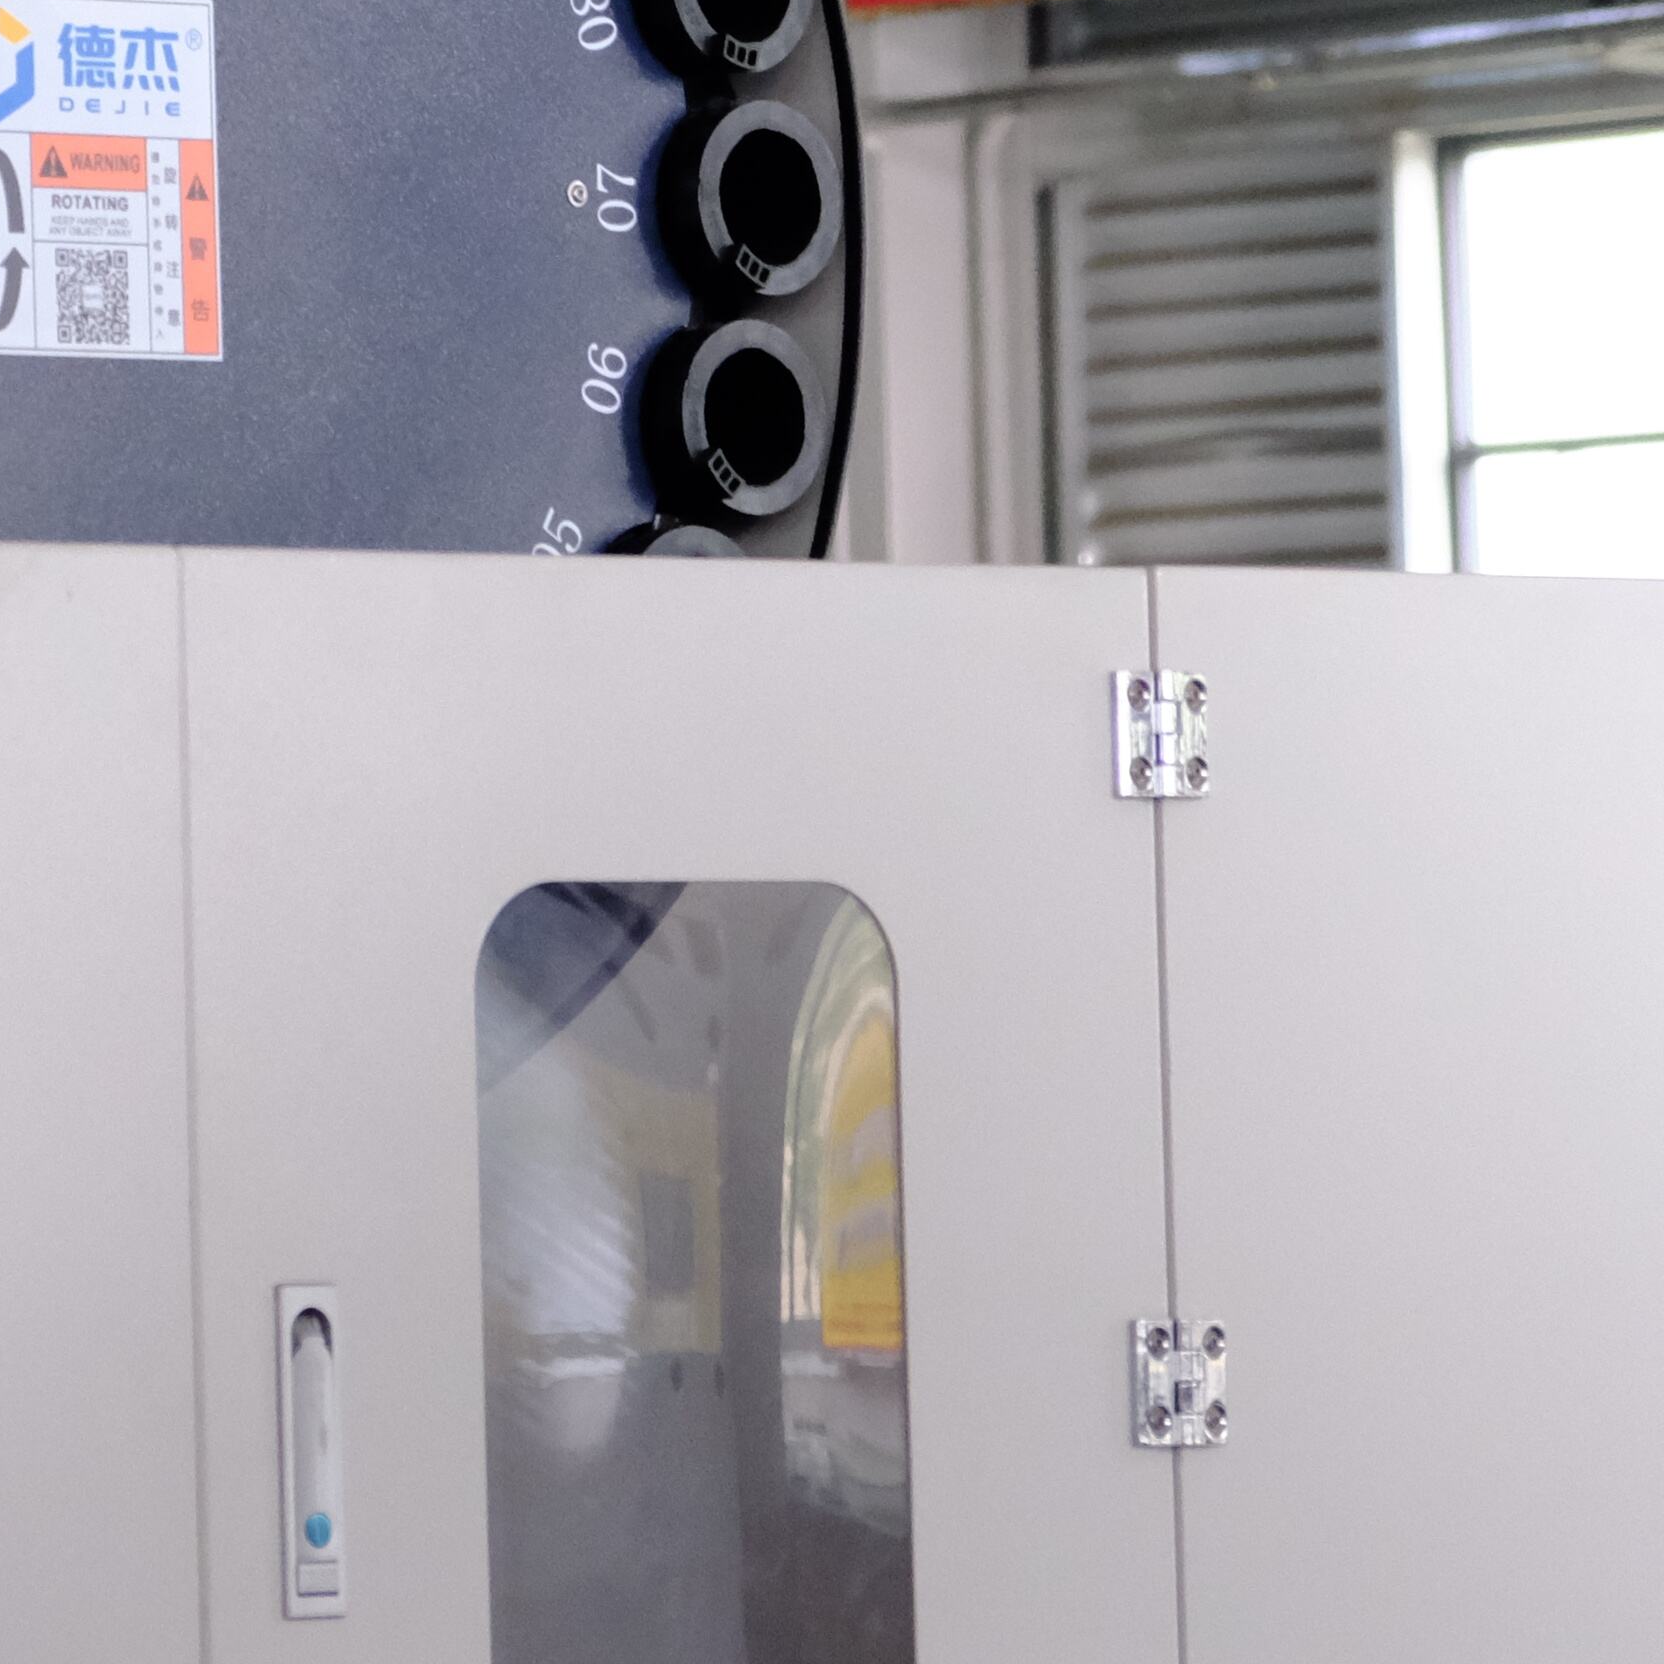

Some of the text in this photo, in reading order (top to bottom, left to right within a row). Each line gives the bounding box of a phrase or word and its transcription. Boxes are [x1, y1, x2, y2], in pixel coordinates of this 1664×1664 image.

[58, 23, 180, 92] 德杰
[59, 97, 181, 117] DEJIE
[70, 152, 140, 174] WARNING
[51, 194, 129, 212] ROTATING
[595, 163, 637, 232] 07
[581, 342, 627, 415] 06
